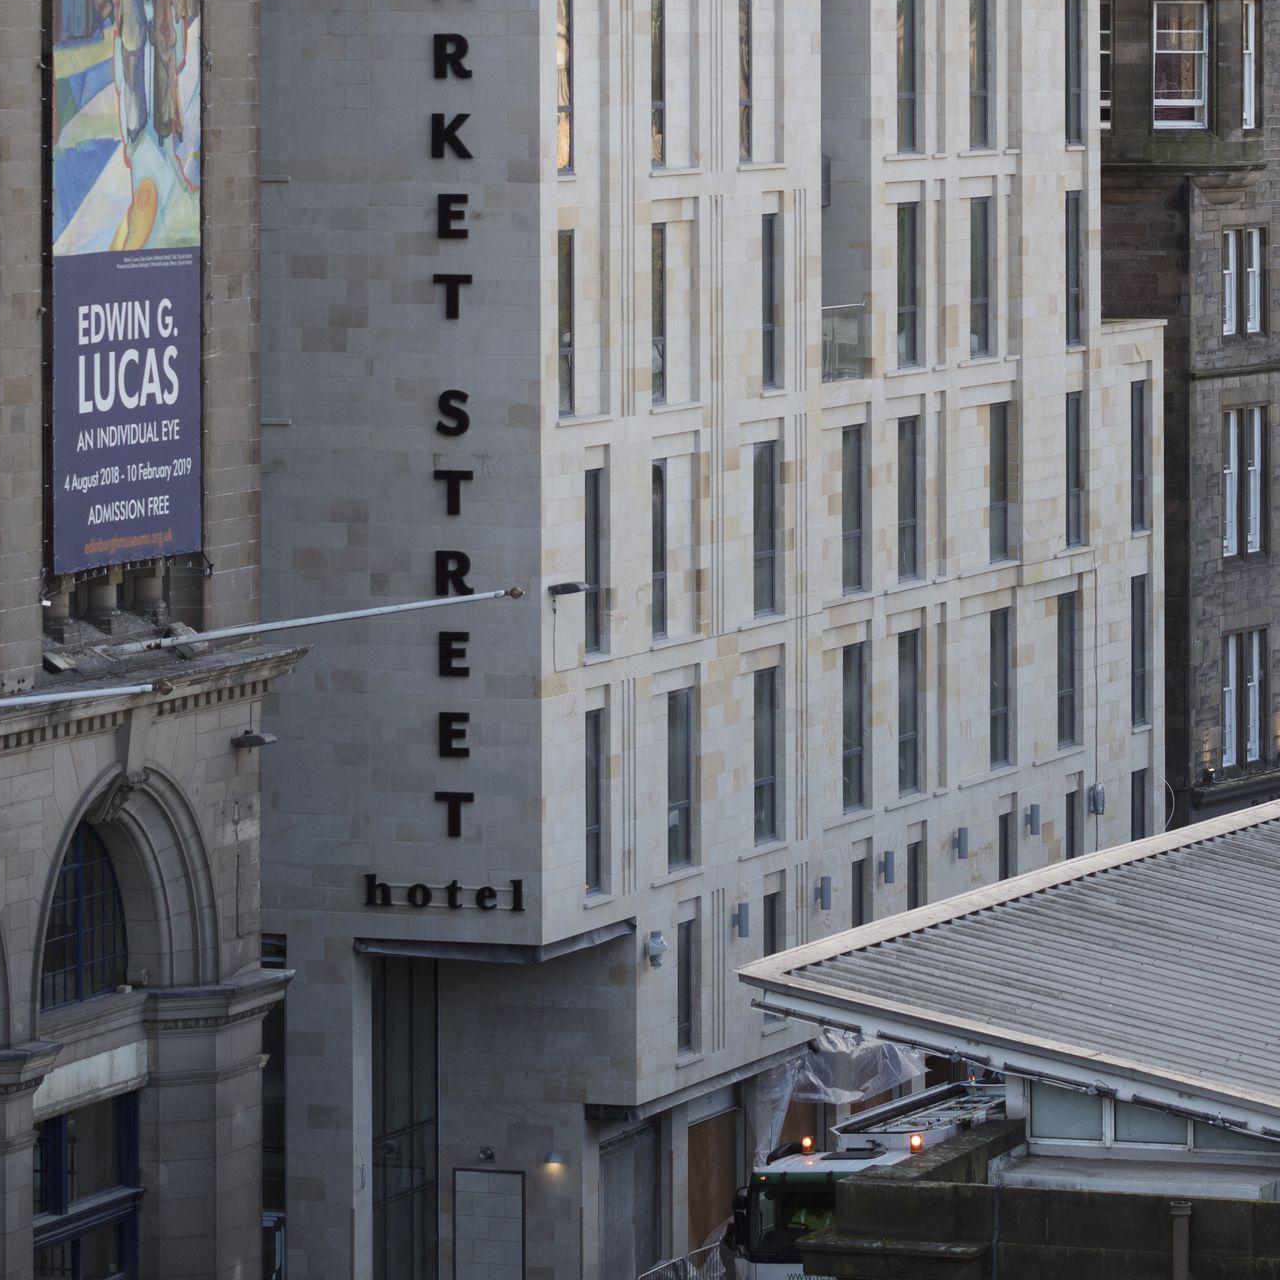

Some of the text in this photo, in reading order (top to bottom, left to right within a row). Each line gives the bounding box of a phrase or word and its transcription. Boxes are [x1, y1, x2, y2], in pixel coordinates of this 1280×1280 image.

[78, 297, 179, 346] EDWIN G.
[78, 344, 180, 414] LUCAS
[76, 419, 180, 452] AN INDIVIDUAL EYE
[63, 474, 70, 491] 4
[71, 471, 99, 493] August
[99, 466, 120, 485] 2018
[126, 464, 137, 482] 10
[138, 461, 172, 482] February
[173, 457, 192, 476] 2019
[87, 495, 170, 526] ADMISSION FREE
[433, 389, 475, 838] STREET
[363, 873, 527, 913] hotel
